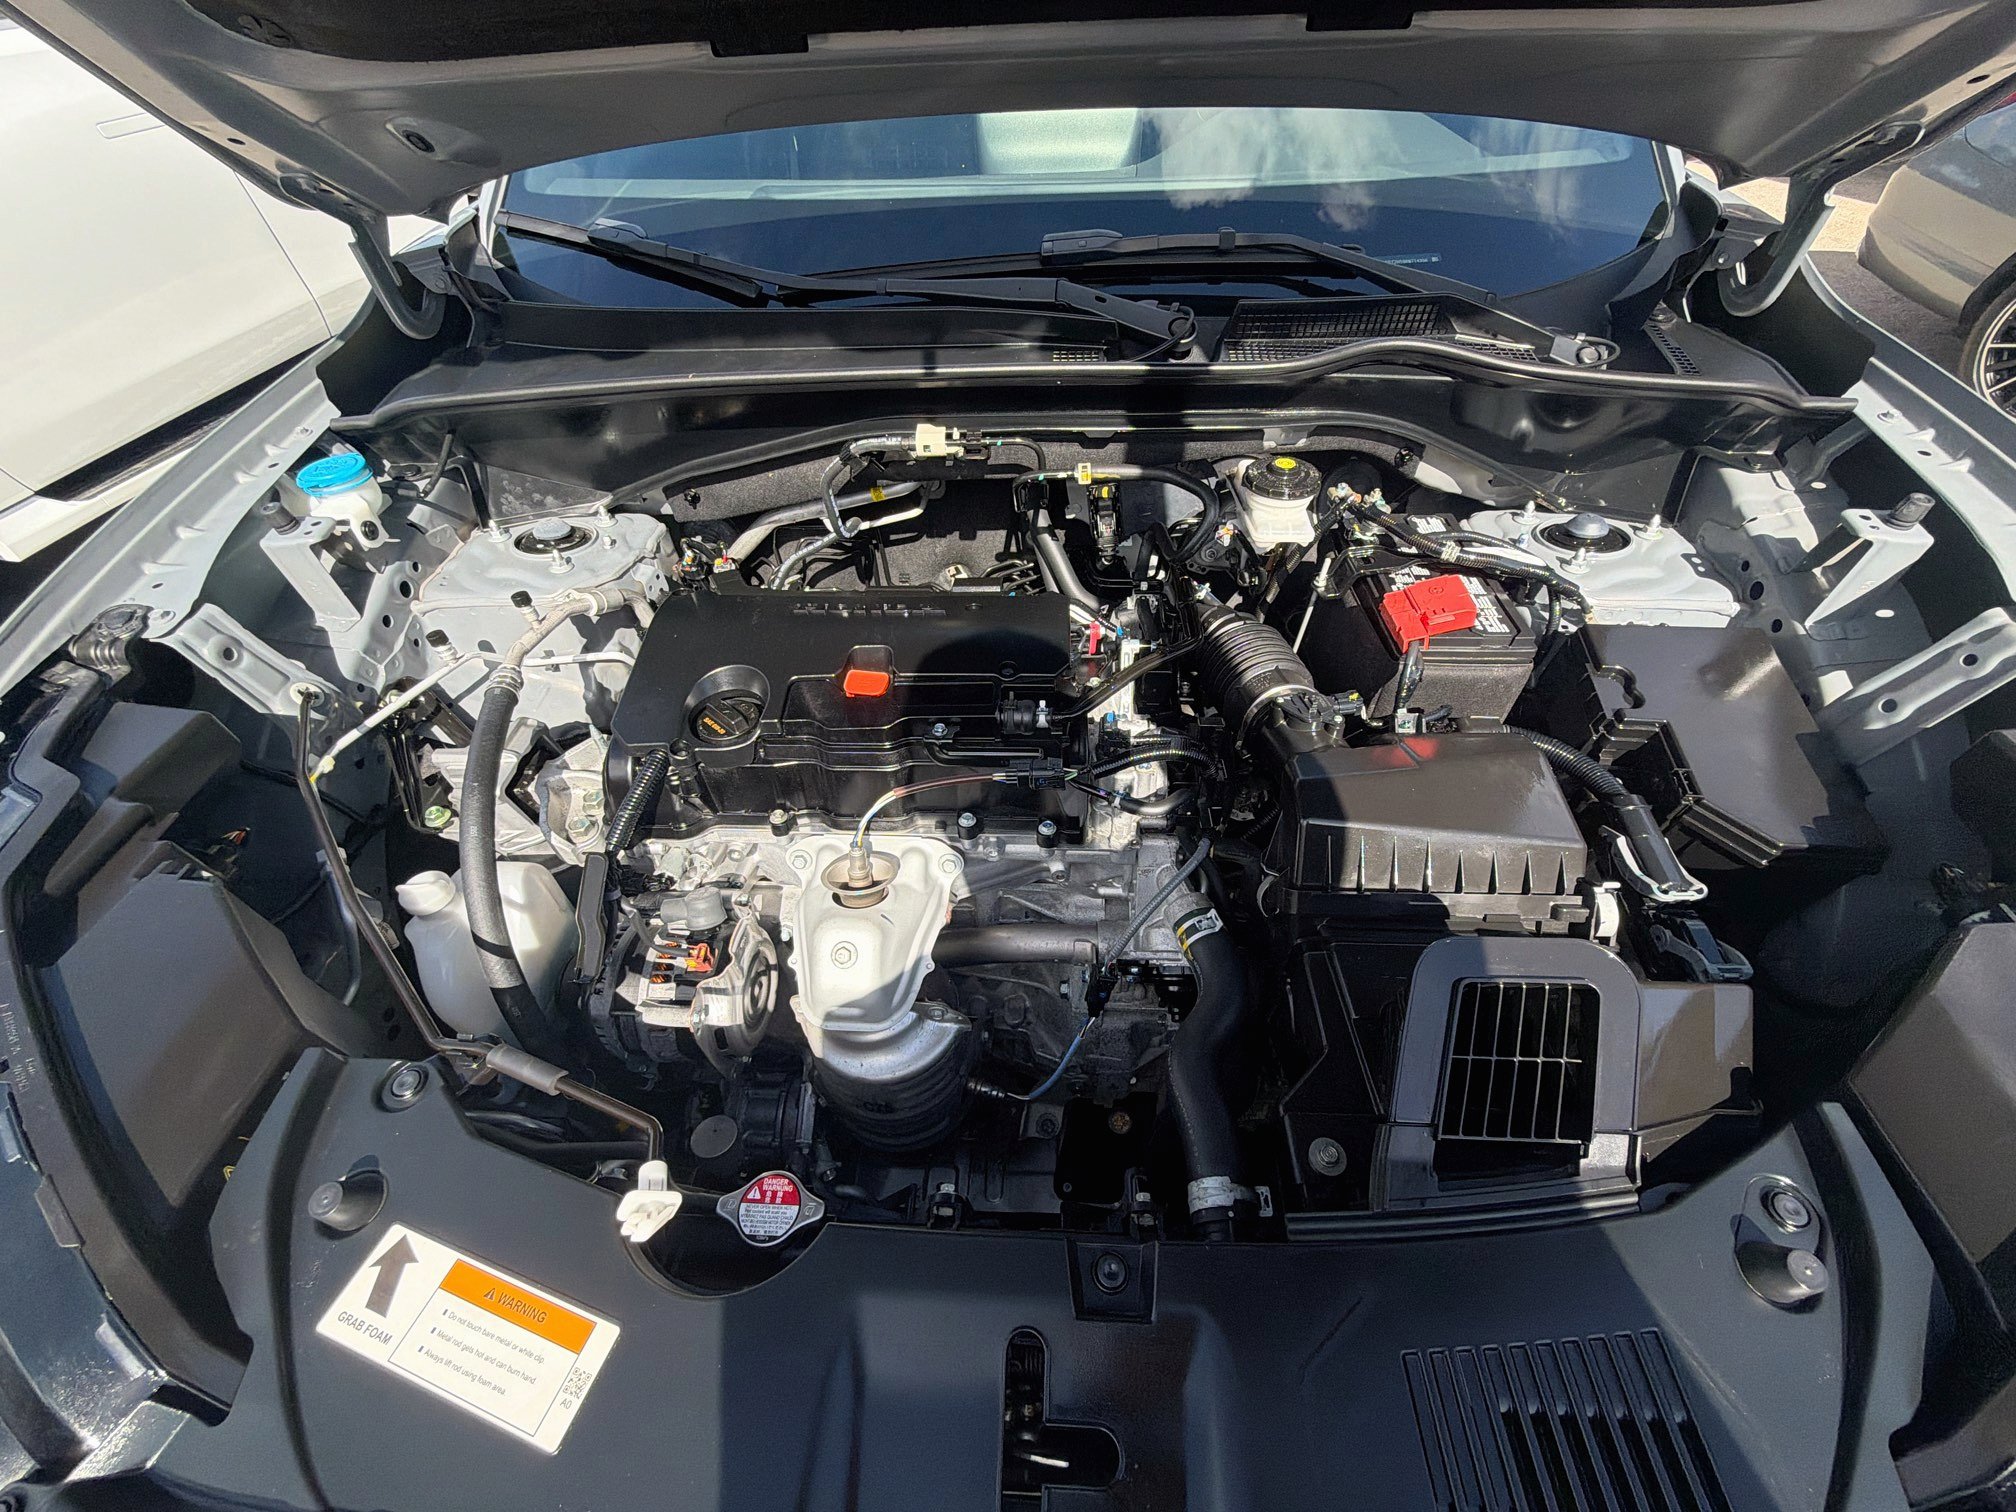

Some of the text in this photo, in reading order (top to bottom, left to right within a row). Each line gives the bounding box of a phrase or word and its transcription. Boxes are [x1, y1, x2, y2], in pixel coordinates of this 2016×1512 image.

[763, 1178, 789, 1187] DANGER
[498, 1292, 547, 1323] WARNING
[337, 1311, 393, 1345] GRAB FOAM
[448, 1311, 458, 1321] Do
[457, 1317, 467, 1326] not
[466, 1321, 482, 1333] touch
[481, 1328, 495, 1340] bare
[495, 1335, 512, 1347] metal
[518, 1347, 534, 1359] white
[424, 1348, 444, 1364] Always
[443, 1358, 453, 1368] lift
[451, 1363, 463, 1373] rod
[461, 1368, 478, 1382] using
[477, 1374, 493, 1389] foam
[437, 1330, 454, 1342] Metal
[452, 1339, 463, 1348] rod
[461, 1344, 475, 1354] gets
[474, 1348, 485, 1359] hot
[484, 1354, 497, 1365] and
[496, 1360, 507, 1370] can
[506, 1365, 521, 1377] burn
